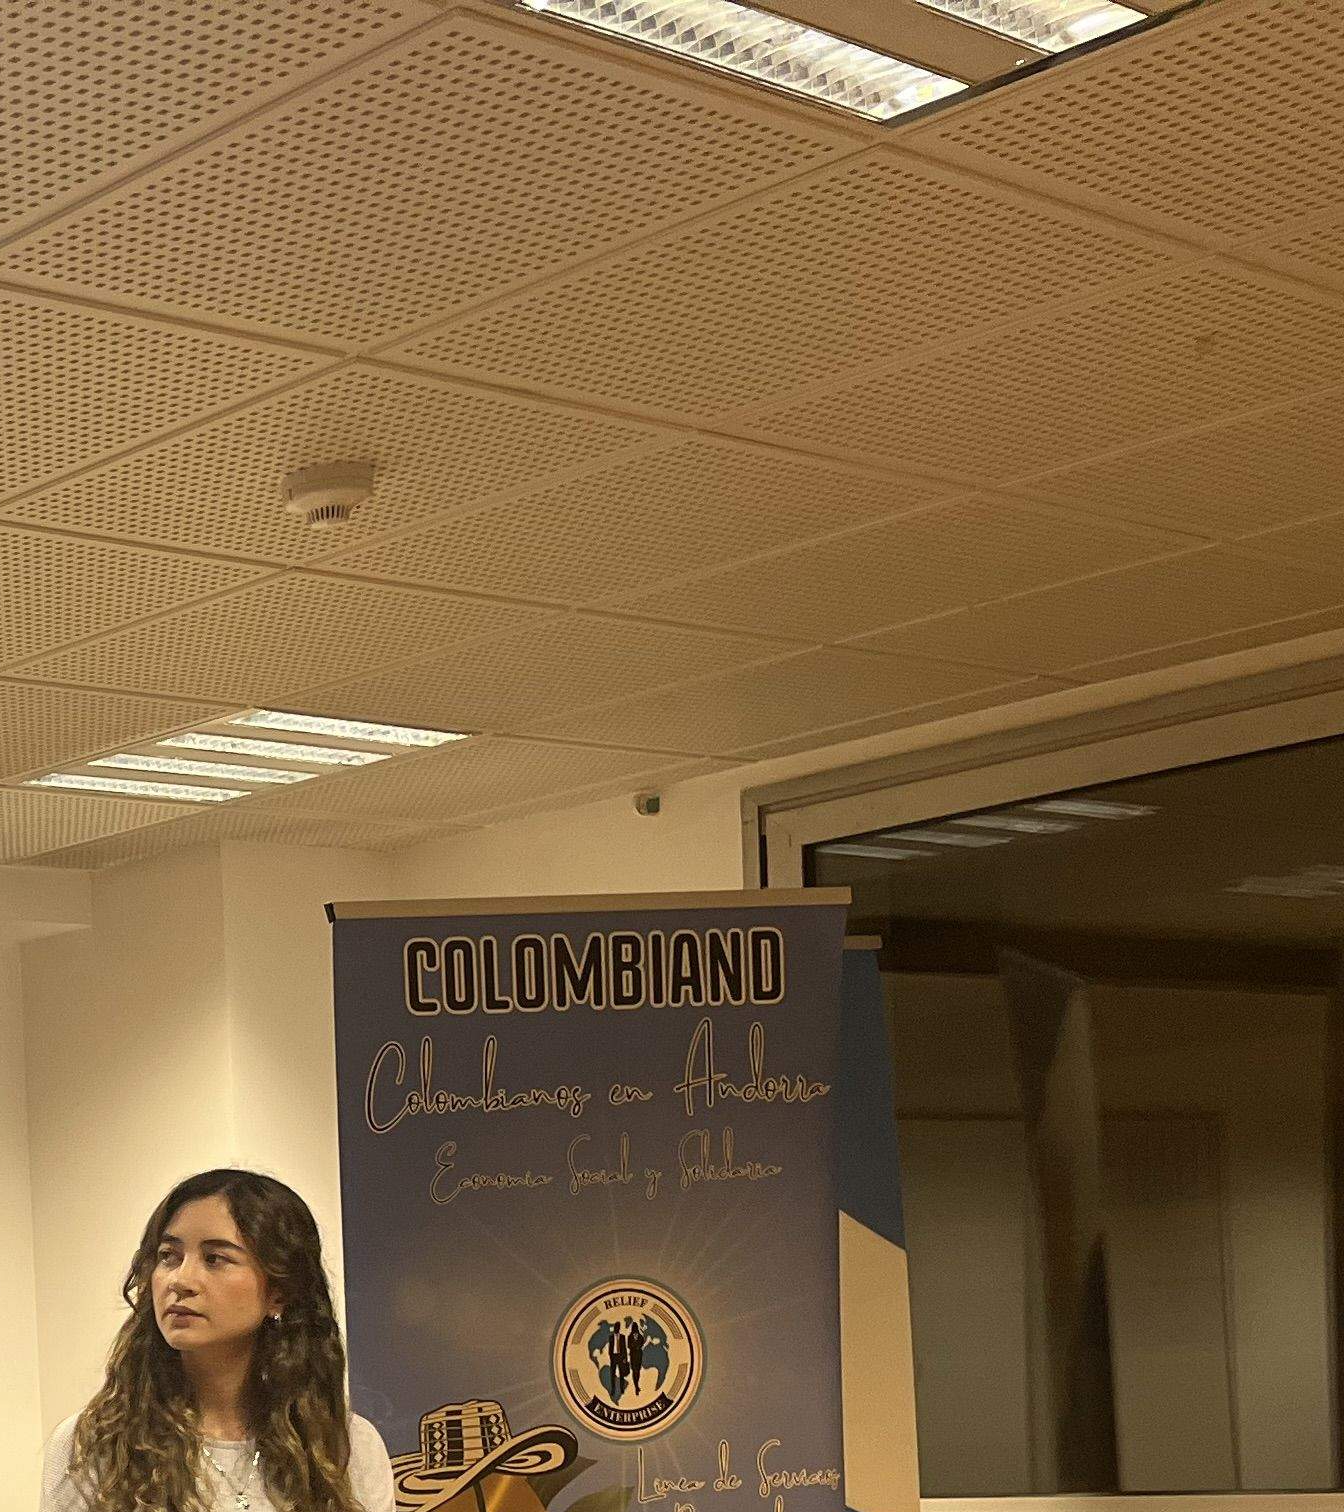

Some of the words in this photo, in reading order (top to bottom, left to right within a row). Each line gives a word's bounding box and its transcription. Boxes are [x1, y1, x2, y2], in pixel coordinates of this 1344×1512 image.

[405, 928, 786, 1016] COLOMBIAND
[366, 1036, 591, 1133] Colombianos
[608, 1082, 653, 1106] en
[673, 1016, 832, 1117] Andorra
[567, 1131, 634, 1196] Social
[643, 1165, 662, 1200] y
[677, 1126, 784, 1191] Solidaria
[604, 1295, 649, 1310] RELIEF
[594, 1401, 666, 1423] ENTERPRISE
[713, 1439, 743, 1492] de
